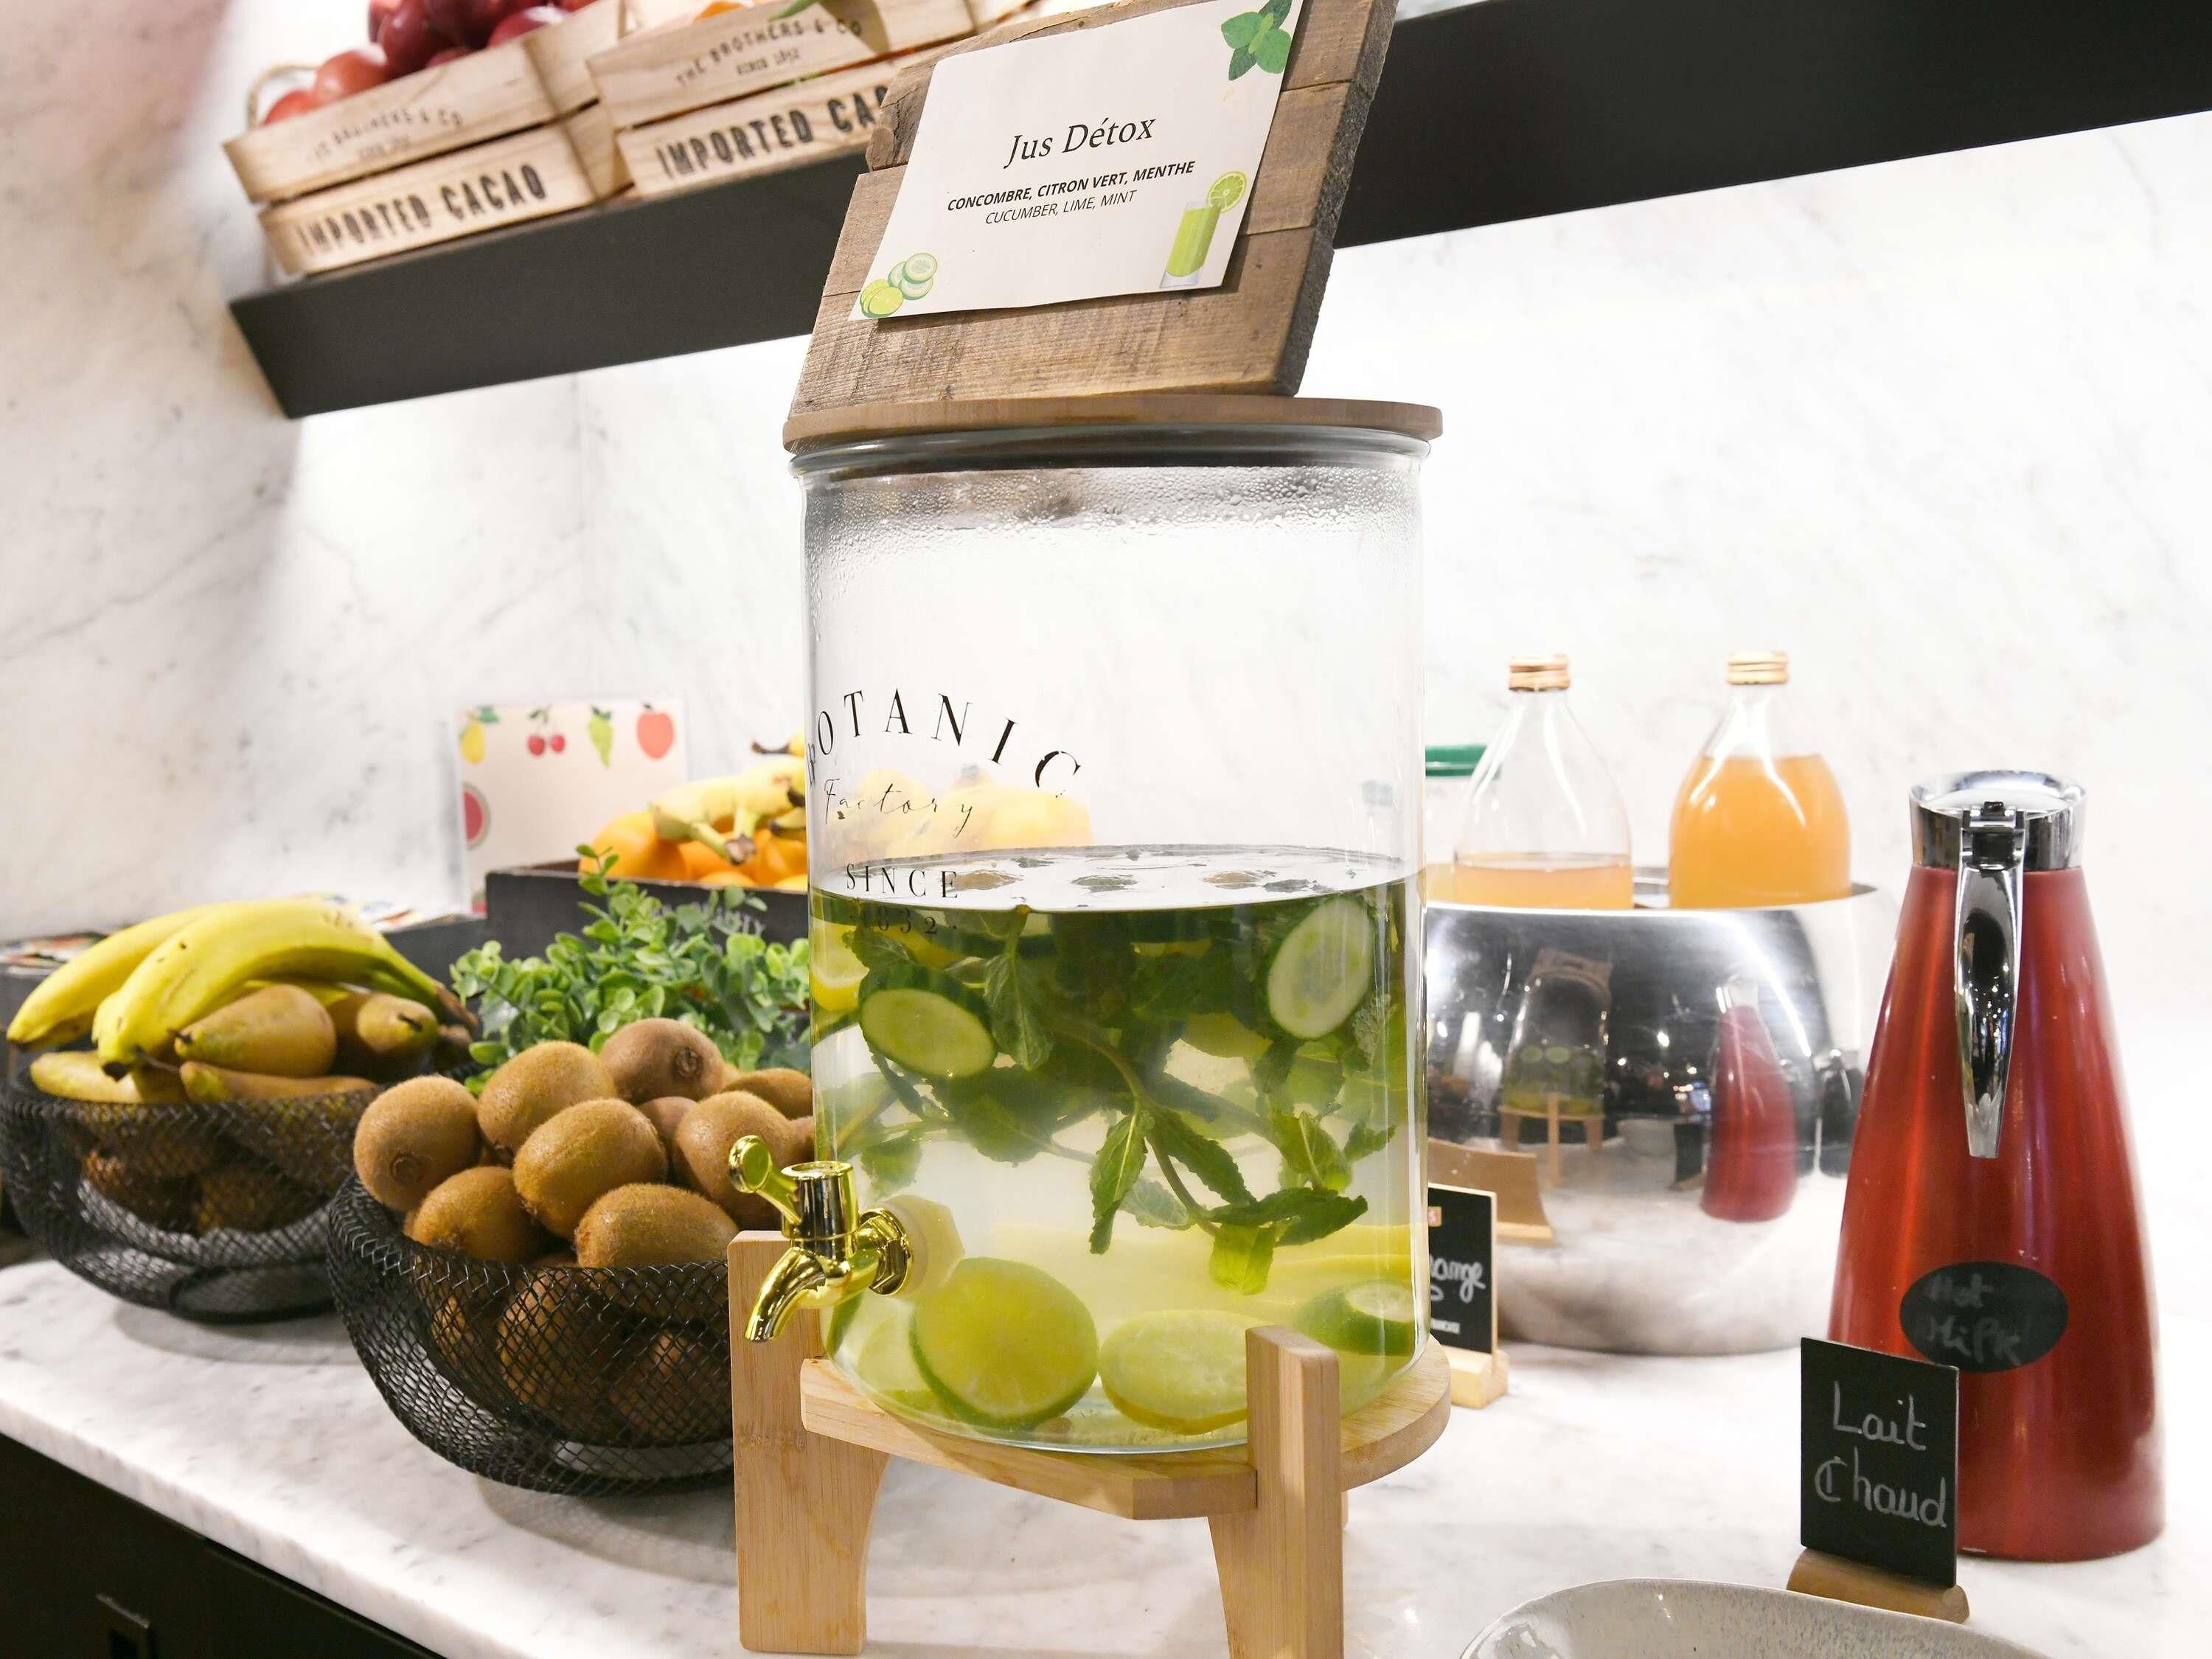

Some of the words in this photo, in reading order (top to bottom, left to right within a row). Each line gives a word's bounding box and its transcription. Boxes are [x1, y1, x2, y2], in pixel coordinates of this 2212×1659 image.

[657, 110, 814, 178] IMPORTED
[1004, 134, 1053, 169] Jus
[1062, 116, 1156, 153] Détox
[296, 195, 431, 255] IMPORTED
[441, 164, 547, 221] CACAO
[947, 187, 1033, 212] CONCOMBRE,
[1037, 178, 1088, 198] CITRON
[1092, 171, 1130, 189] VERT,
[1132, 161, 1196, 182] MENTHE
[986, 203, 1059, 225] CUCUMBER,
[1062, 197, 1096, 214] LIME,
[1100, 189, 1138, 206] MINT
[846, 863, 958, 898] SINCE
[1833, 1380, 1927, 1451] Lait
[1814, 1446, 1947, 1528] Chaud
